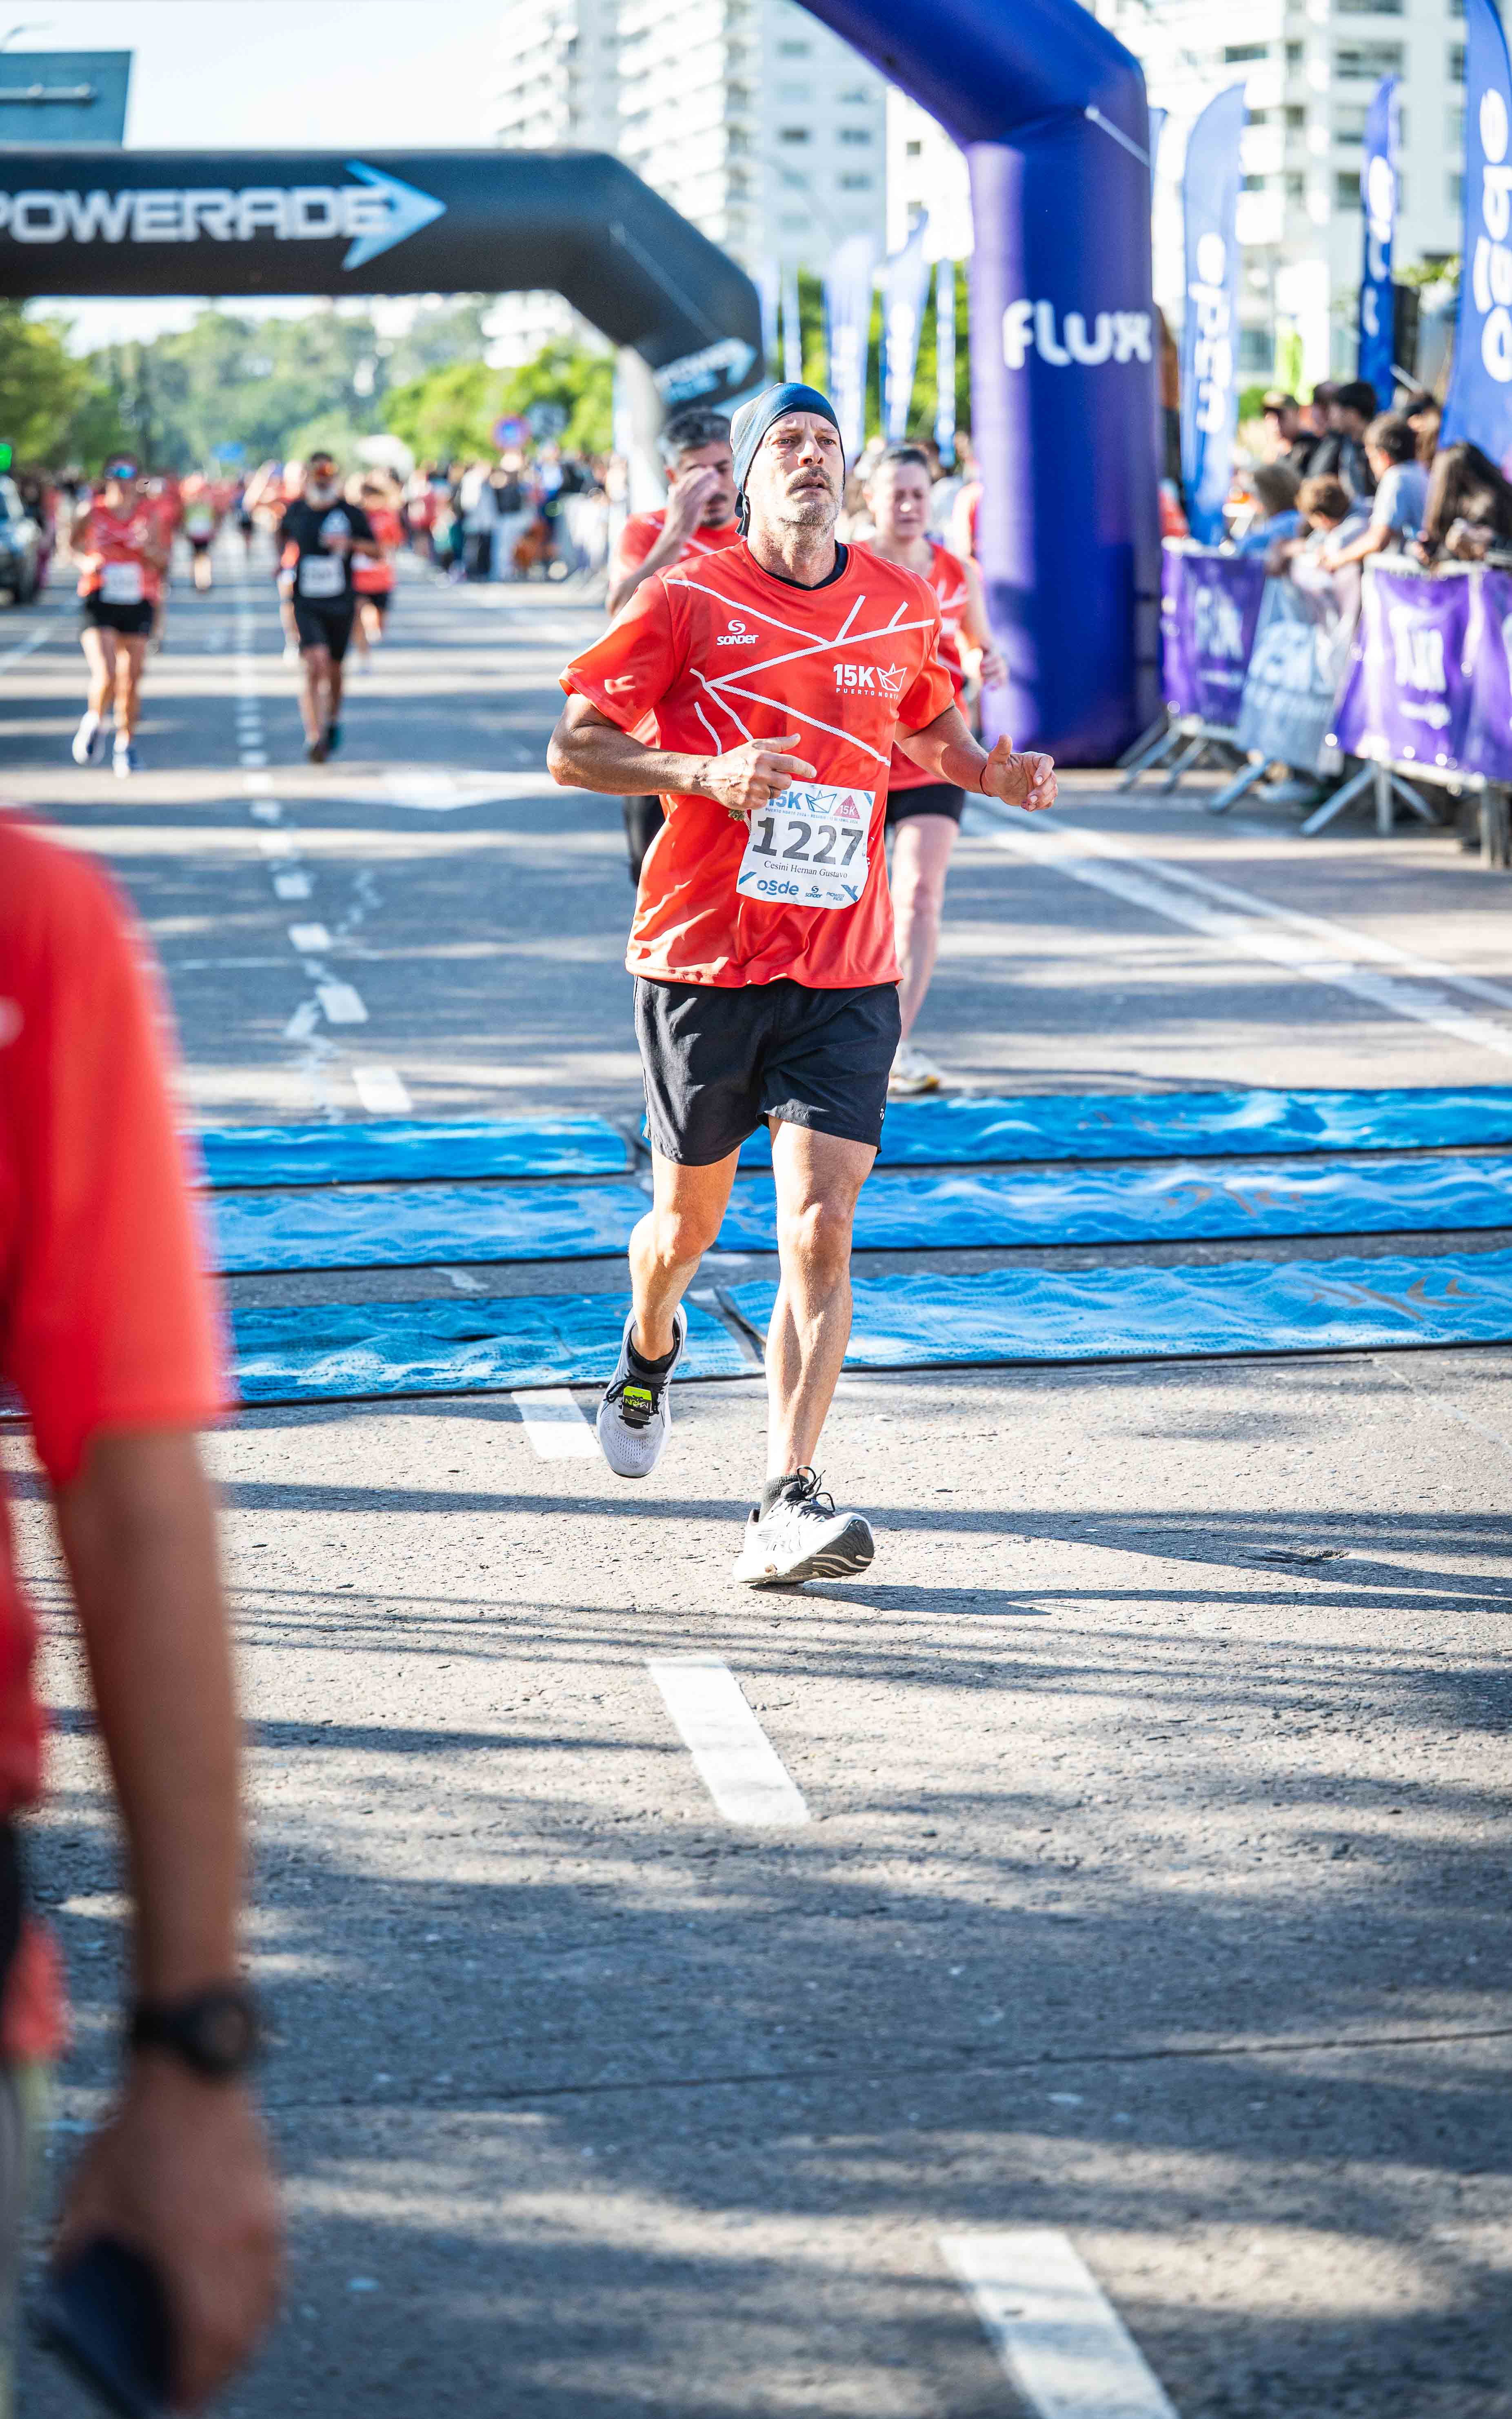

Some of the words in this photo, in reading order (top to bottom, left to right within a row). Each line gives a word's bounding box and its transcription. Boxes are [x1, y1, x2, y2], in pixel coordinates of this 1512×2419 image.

[0, 188, 389, 244] OWERADE
[833, 664, 875, 688] 15K
[836, 687, 875, 696] PUERTO
[841, 805, 855, 815] 15K
[752, 817, 864, 866] 1227
[764, 860, 788, 871] Cesini
[790, 864, 817, 875] Hernan
[819, 869, 848, 878] Gustavo
[757, 880, 799, 895] osde
